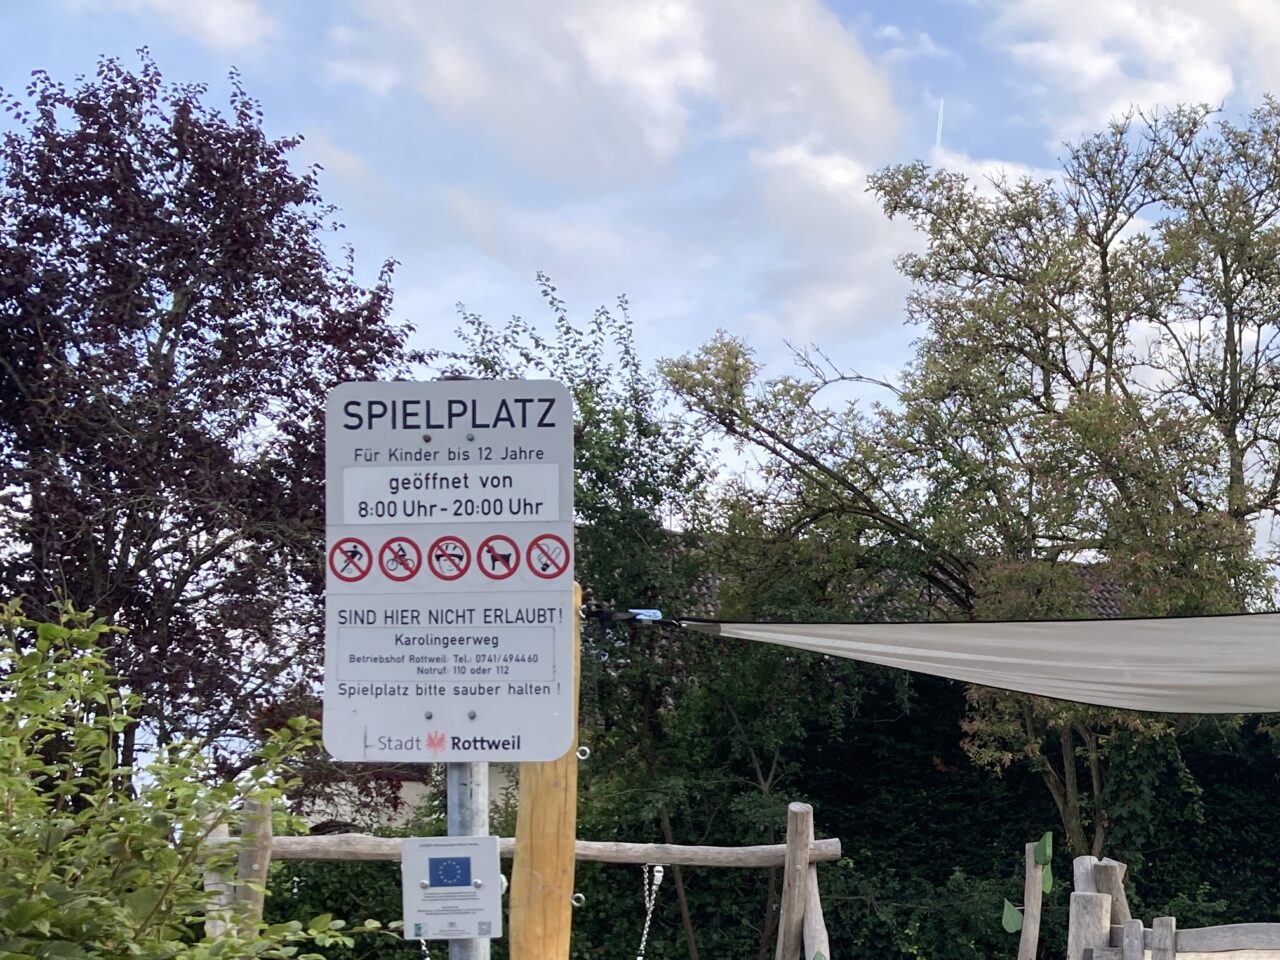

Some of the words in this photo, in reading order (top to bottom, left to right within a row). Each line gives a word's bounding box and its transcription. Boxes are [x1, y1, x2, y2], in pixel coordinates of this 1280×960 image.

[343, 398, 556, 430] SPIELPLATZ
[354, 448, 380, 462] Für
[389, 448, 440, 461] Kinder
[448, 448, 469, 461] bis
[478, 447, 492, 460] 12
[501, 447, 544, 460] Jahre
[389, 473, 469, 494] geöffnet
[480, 475, 512, 488] von
[358, 501, 396, 517] 8:00
[403, 501, 437, 517] Uhr
[453, 500, 503, 516] 20:00
[509, 499, 543, 515] Uhr
[338, 610, 376, 625] SIND
[385, 610, 420, 624] HIER
[429, 609, 475, 624] NICHT
[484, 608, 563, 623] ERLAUBT!
[395, 634, 499, 648] Karolingeerweg
[349, 655, 405, 663] Betriebshof
[453, 666, 466, 675] 110
[470, 666, 491, 675] oder
[496, 666, 509, 674] 112
[338, 684, 408, 698] Spielplatz
[416, 683, 446, 696] bitte
[453, 684, 499, 695] sauber
[508, 683, 550, 695] halten
[378, 736, 421, 750] Stadt
[451, 735, 520, 750] Rottweil
